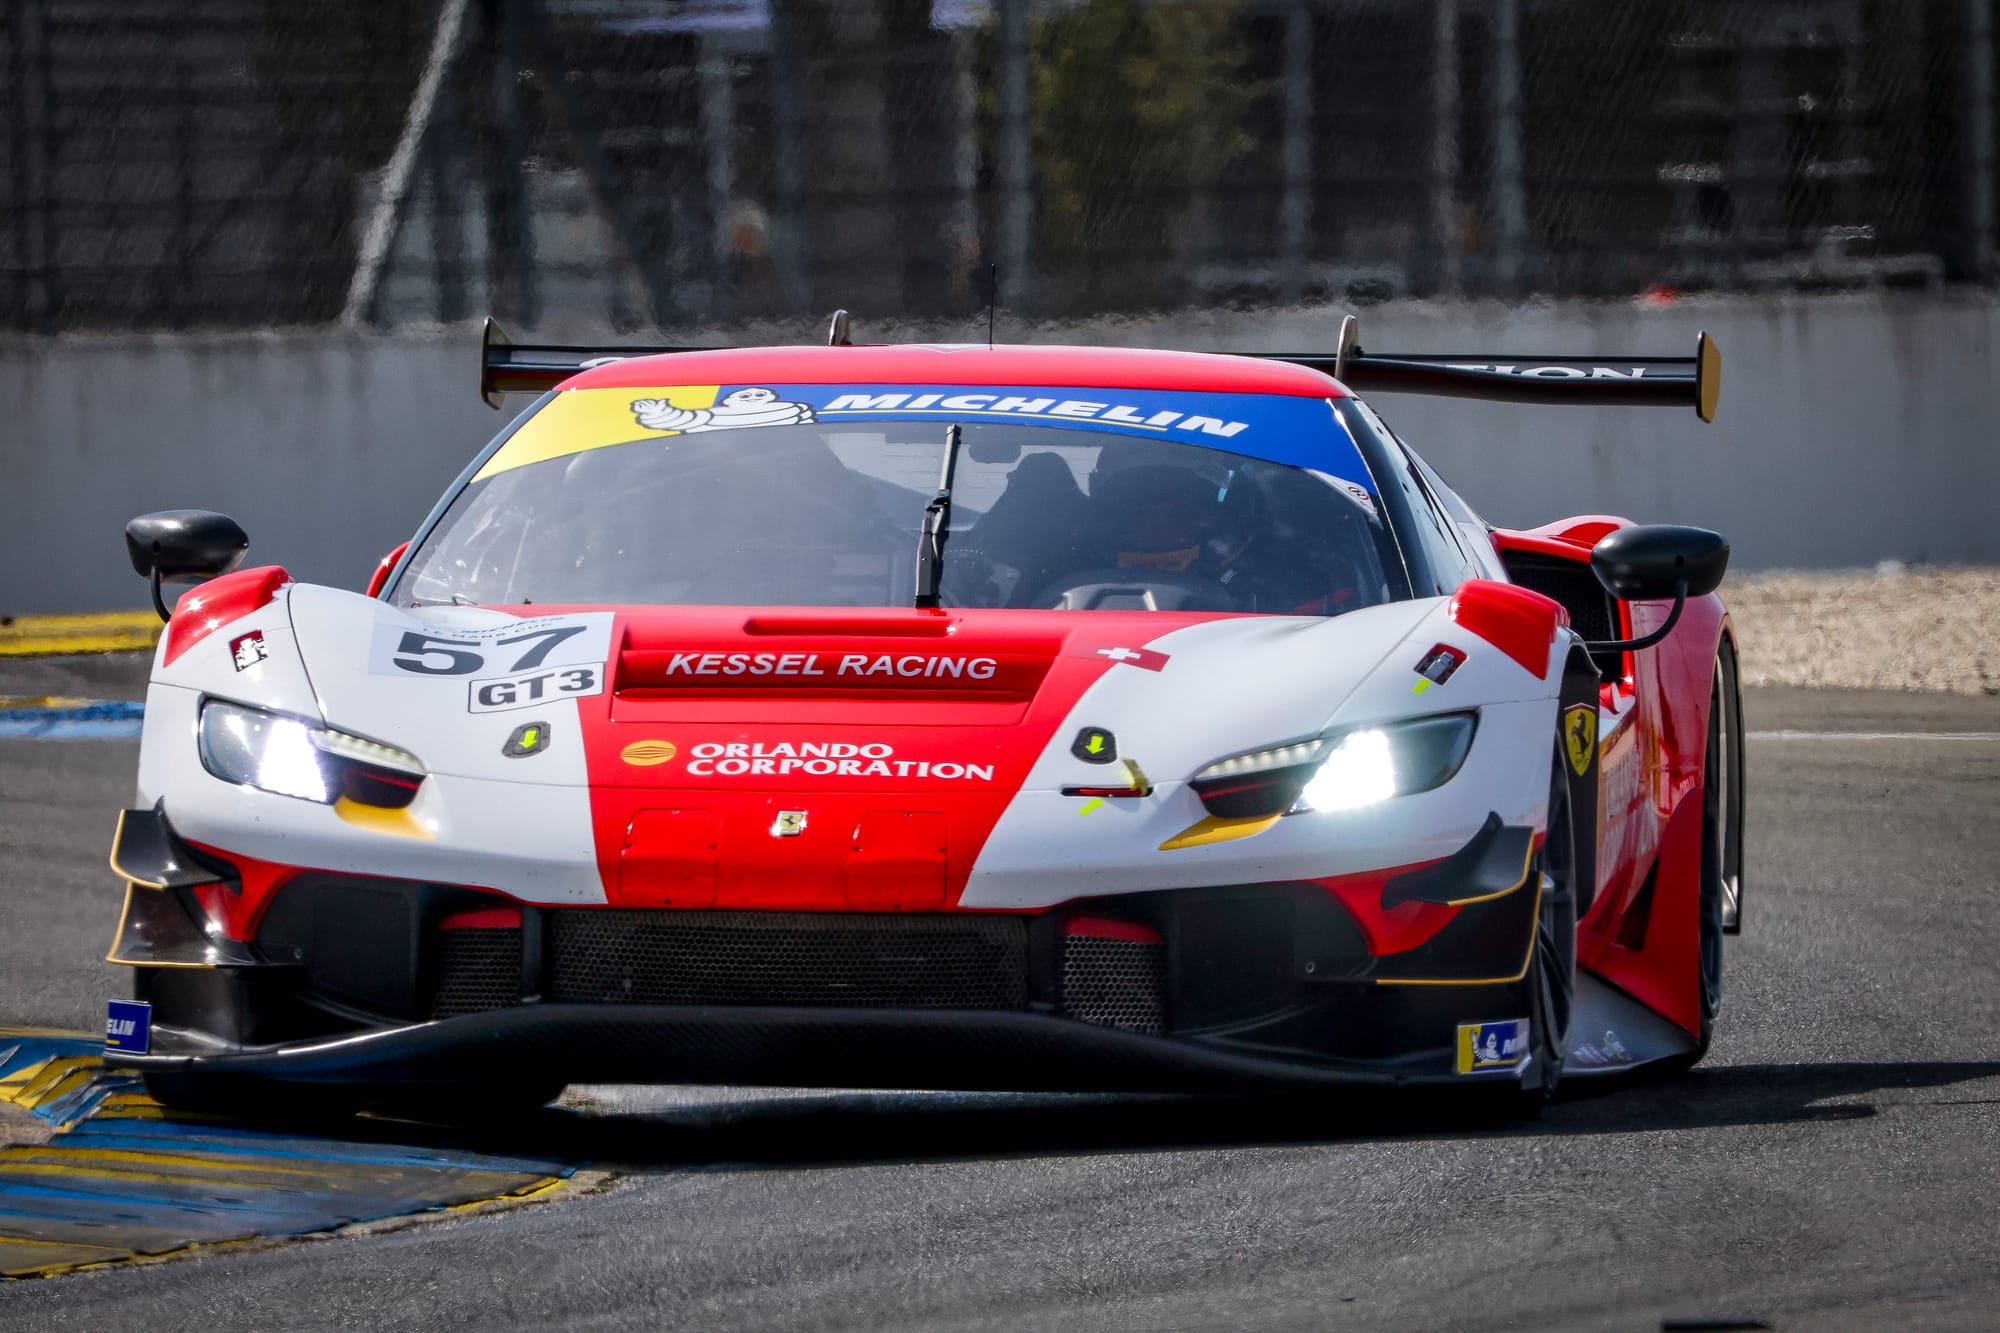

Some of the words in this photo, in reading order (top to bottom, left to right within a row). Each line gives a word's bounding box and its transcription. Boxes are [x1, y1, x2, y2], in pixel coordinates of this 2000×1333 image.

[1446, 364, 1647, 379] ION
[822, 393, 1250, 438] MICHELIN
[393, 625, 588, 676] 57
[666, 653, 824, 676] KESSEL
[837, 654, 998, 680] RACING
[478, 669, 595, 706] GT3
[690, 742, 894, 759] ORLANDO
[686, 757, 995, 782] CORPORATION
